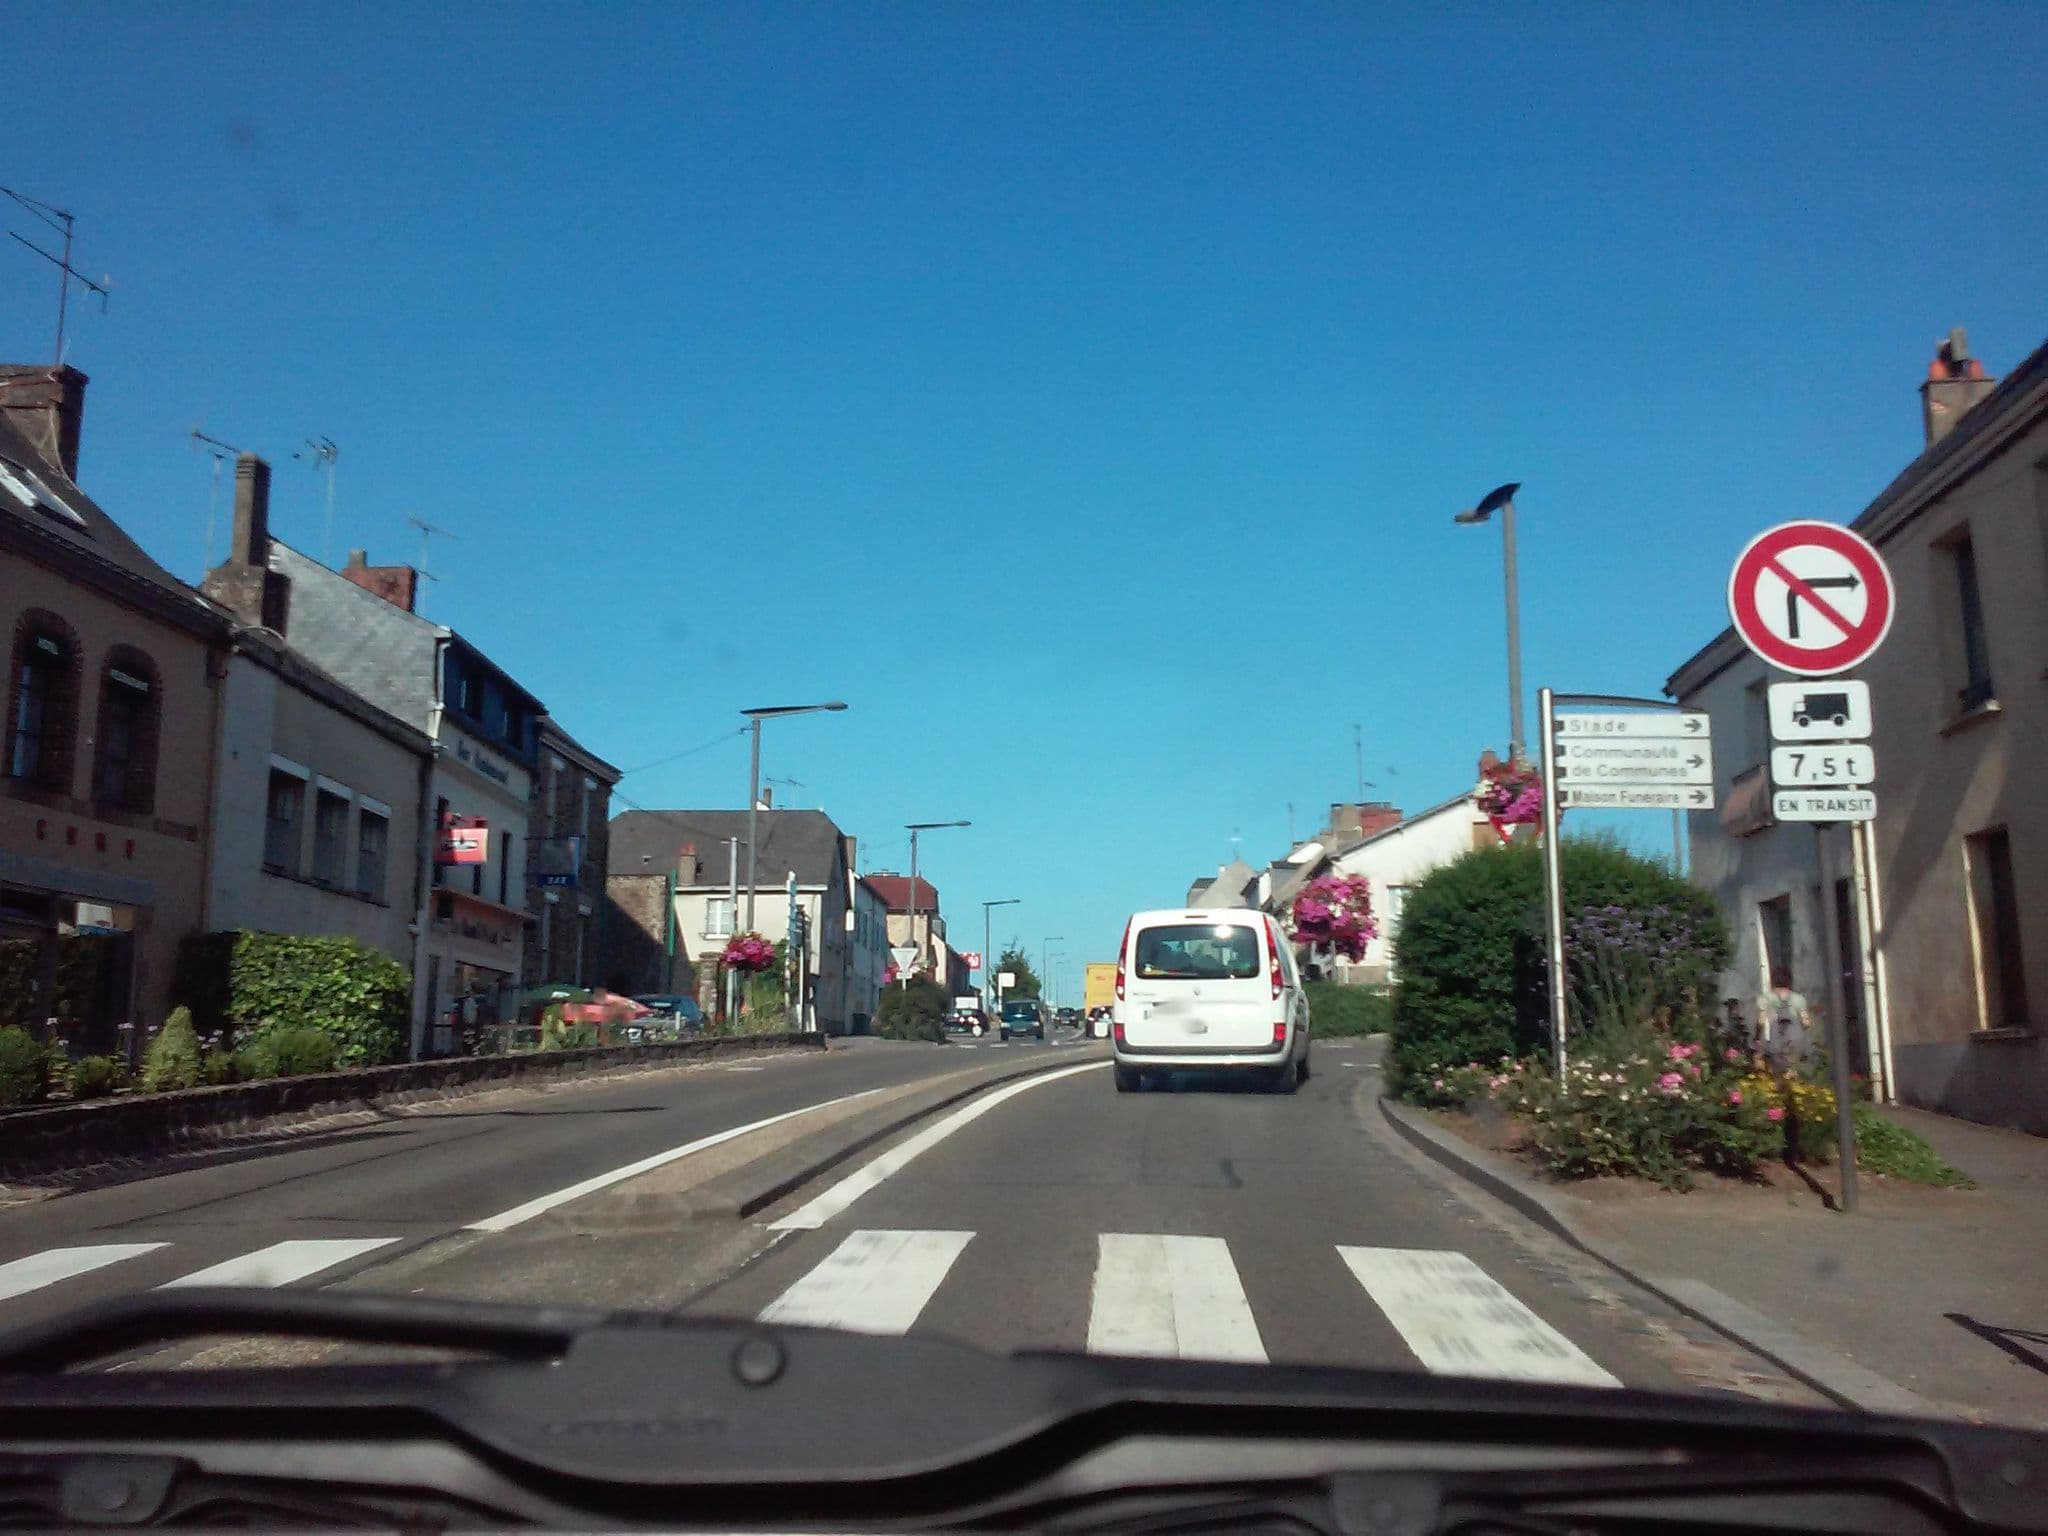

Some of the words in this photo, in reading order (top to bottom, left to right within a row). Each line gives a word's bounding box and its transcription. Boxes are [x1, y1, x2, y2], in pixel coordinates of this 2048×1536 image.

[1571, 720, 1627, 732] Stade
[1572, 745, 1678, 758] Communauté
[1572, 765, 1591, 777] de
[1597, 764, 1688, 777] Communes
[1573, 790, 1616, 803] Maison
[1778, 799, 1799, 812] EN
[1807, 798, 1873, 812] TRANSIT
